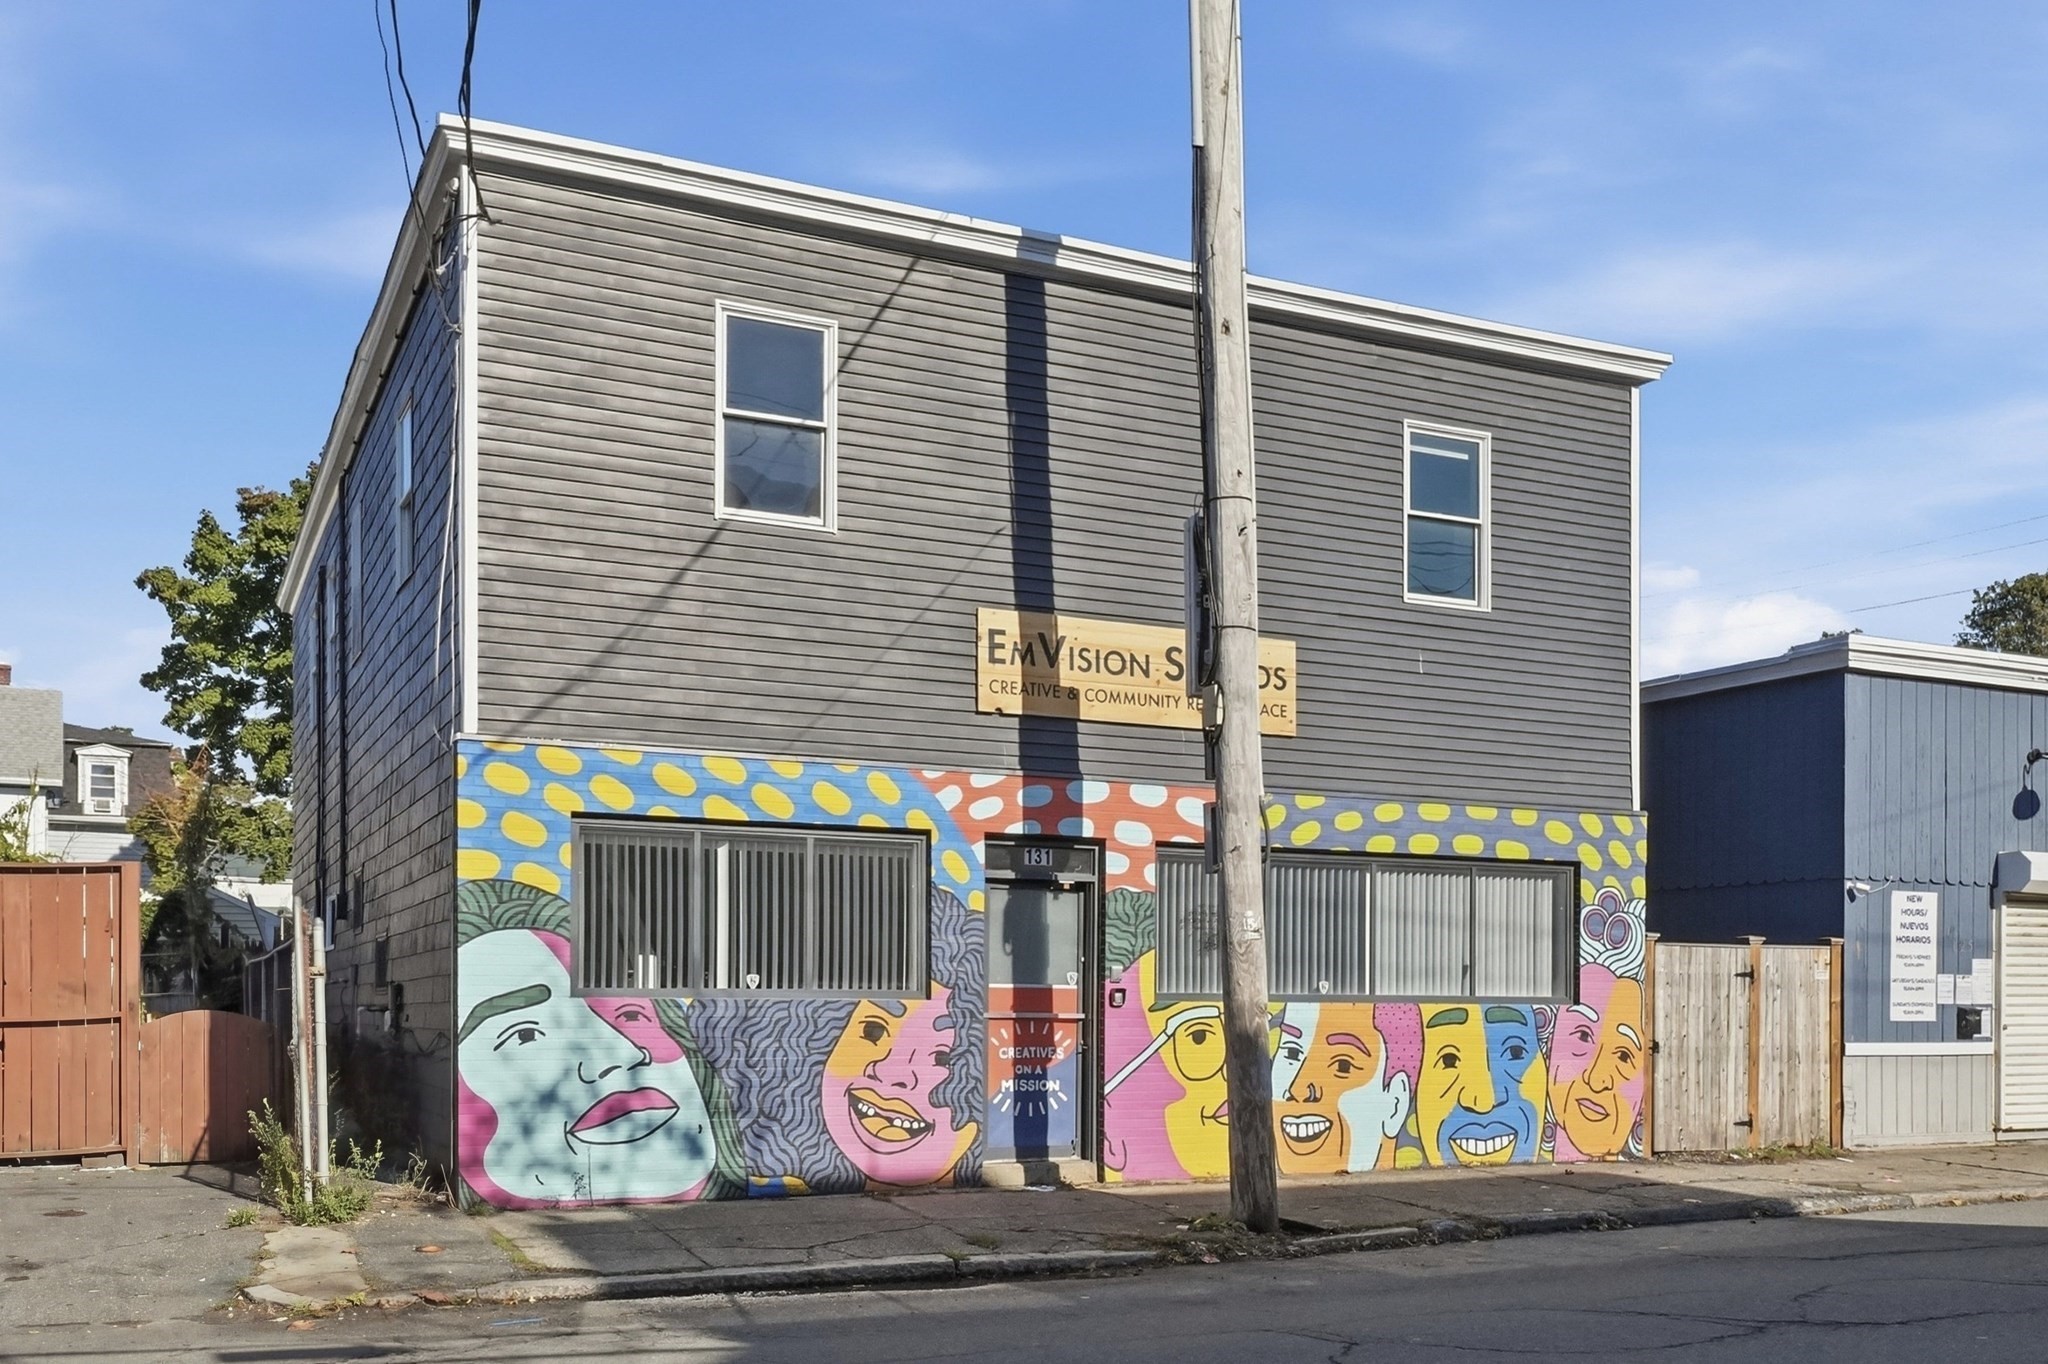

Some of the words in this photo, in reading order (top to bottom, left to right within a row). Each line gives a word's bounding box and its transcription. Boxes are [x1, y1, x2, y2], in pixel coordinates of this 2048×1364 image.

[989, 679, 1061, 698] CREATIVE
[1067, 686, 1078, 700] &
[1084, 688, 1181, 709] COMMUNITY
[1026, 848, 1050, 865] 131
[1906, 895, 1923, 903] NEW
[1900, 922, 1929, 931] NUEVOS
[1895, 935, 1932, 944] HORARIOS
[998, 1046, 1065, 1059] CREATIVES
[1015, 1064, 1032, 1074] ON
[1034, 1064, 1042, 1074] A
[1001, 1079, 1060, 1092] MISSION
